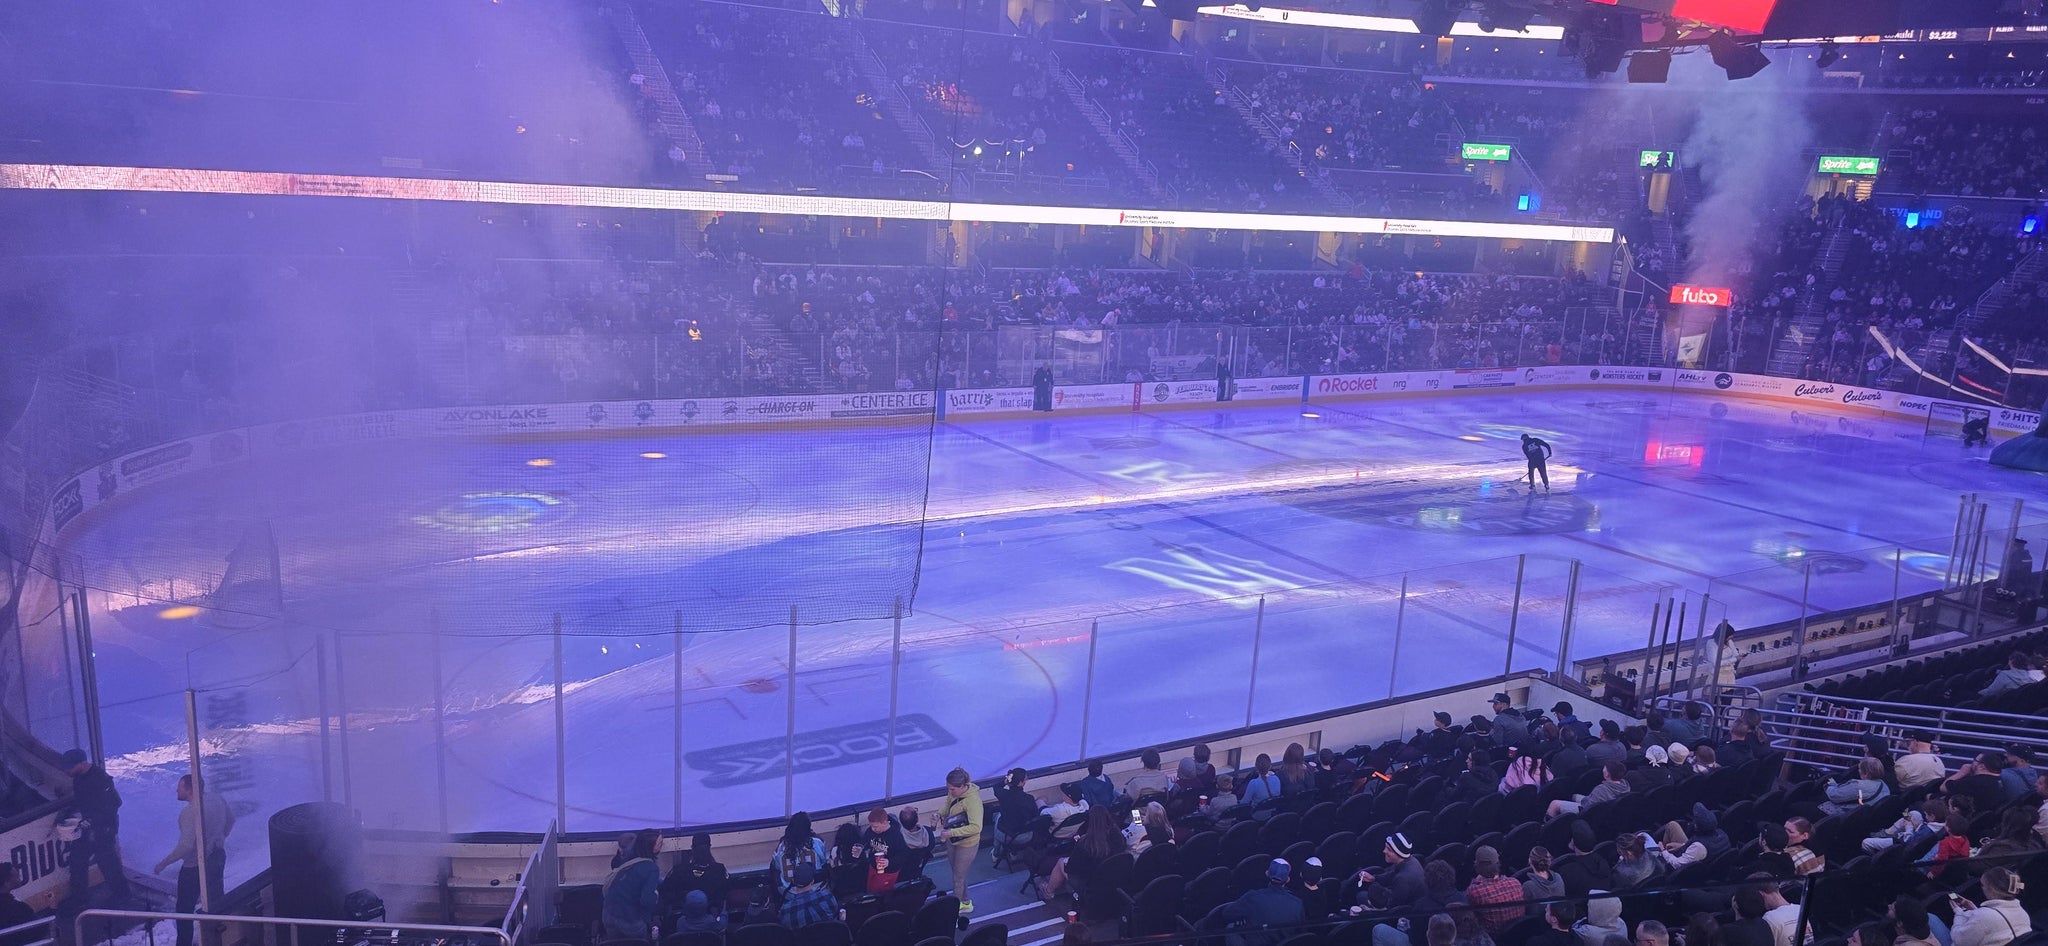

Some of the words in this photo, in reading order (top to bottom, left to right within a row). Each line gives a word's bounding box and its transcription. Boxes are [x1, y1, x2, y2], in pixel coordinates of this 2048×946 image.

[1928, 31, 1957, 40] $2,223
[1466, 146, 1489, 157] Sprite
[1822, 159, 1852, 170] Sprite
[1682, 287, 1718, 305] fubo
[1270, 383, 1300, 391] ENBRIDGE
[1331, 376, 1379, 392] Rocket
[1393, 380, 1407, 390] nrg
[1426, 379, 1440, 389] nrg
[1794, 384, 1835, 397] Culver's
[851, 393, 905, 409] CENTER
[908, 393, 928, 407] ICE
[1842, 390, 1882, 403] Culver's
[799, 400, 814, 412] ON
[1899, 400, 1927, 411] NOPEC
[2012, 413, 2040, 424] HITS
